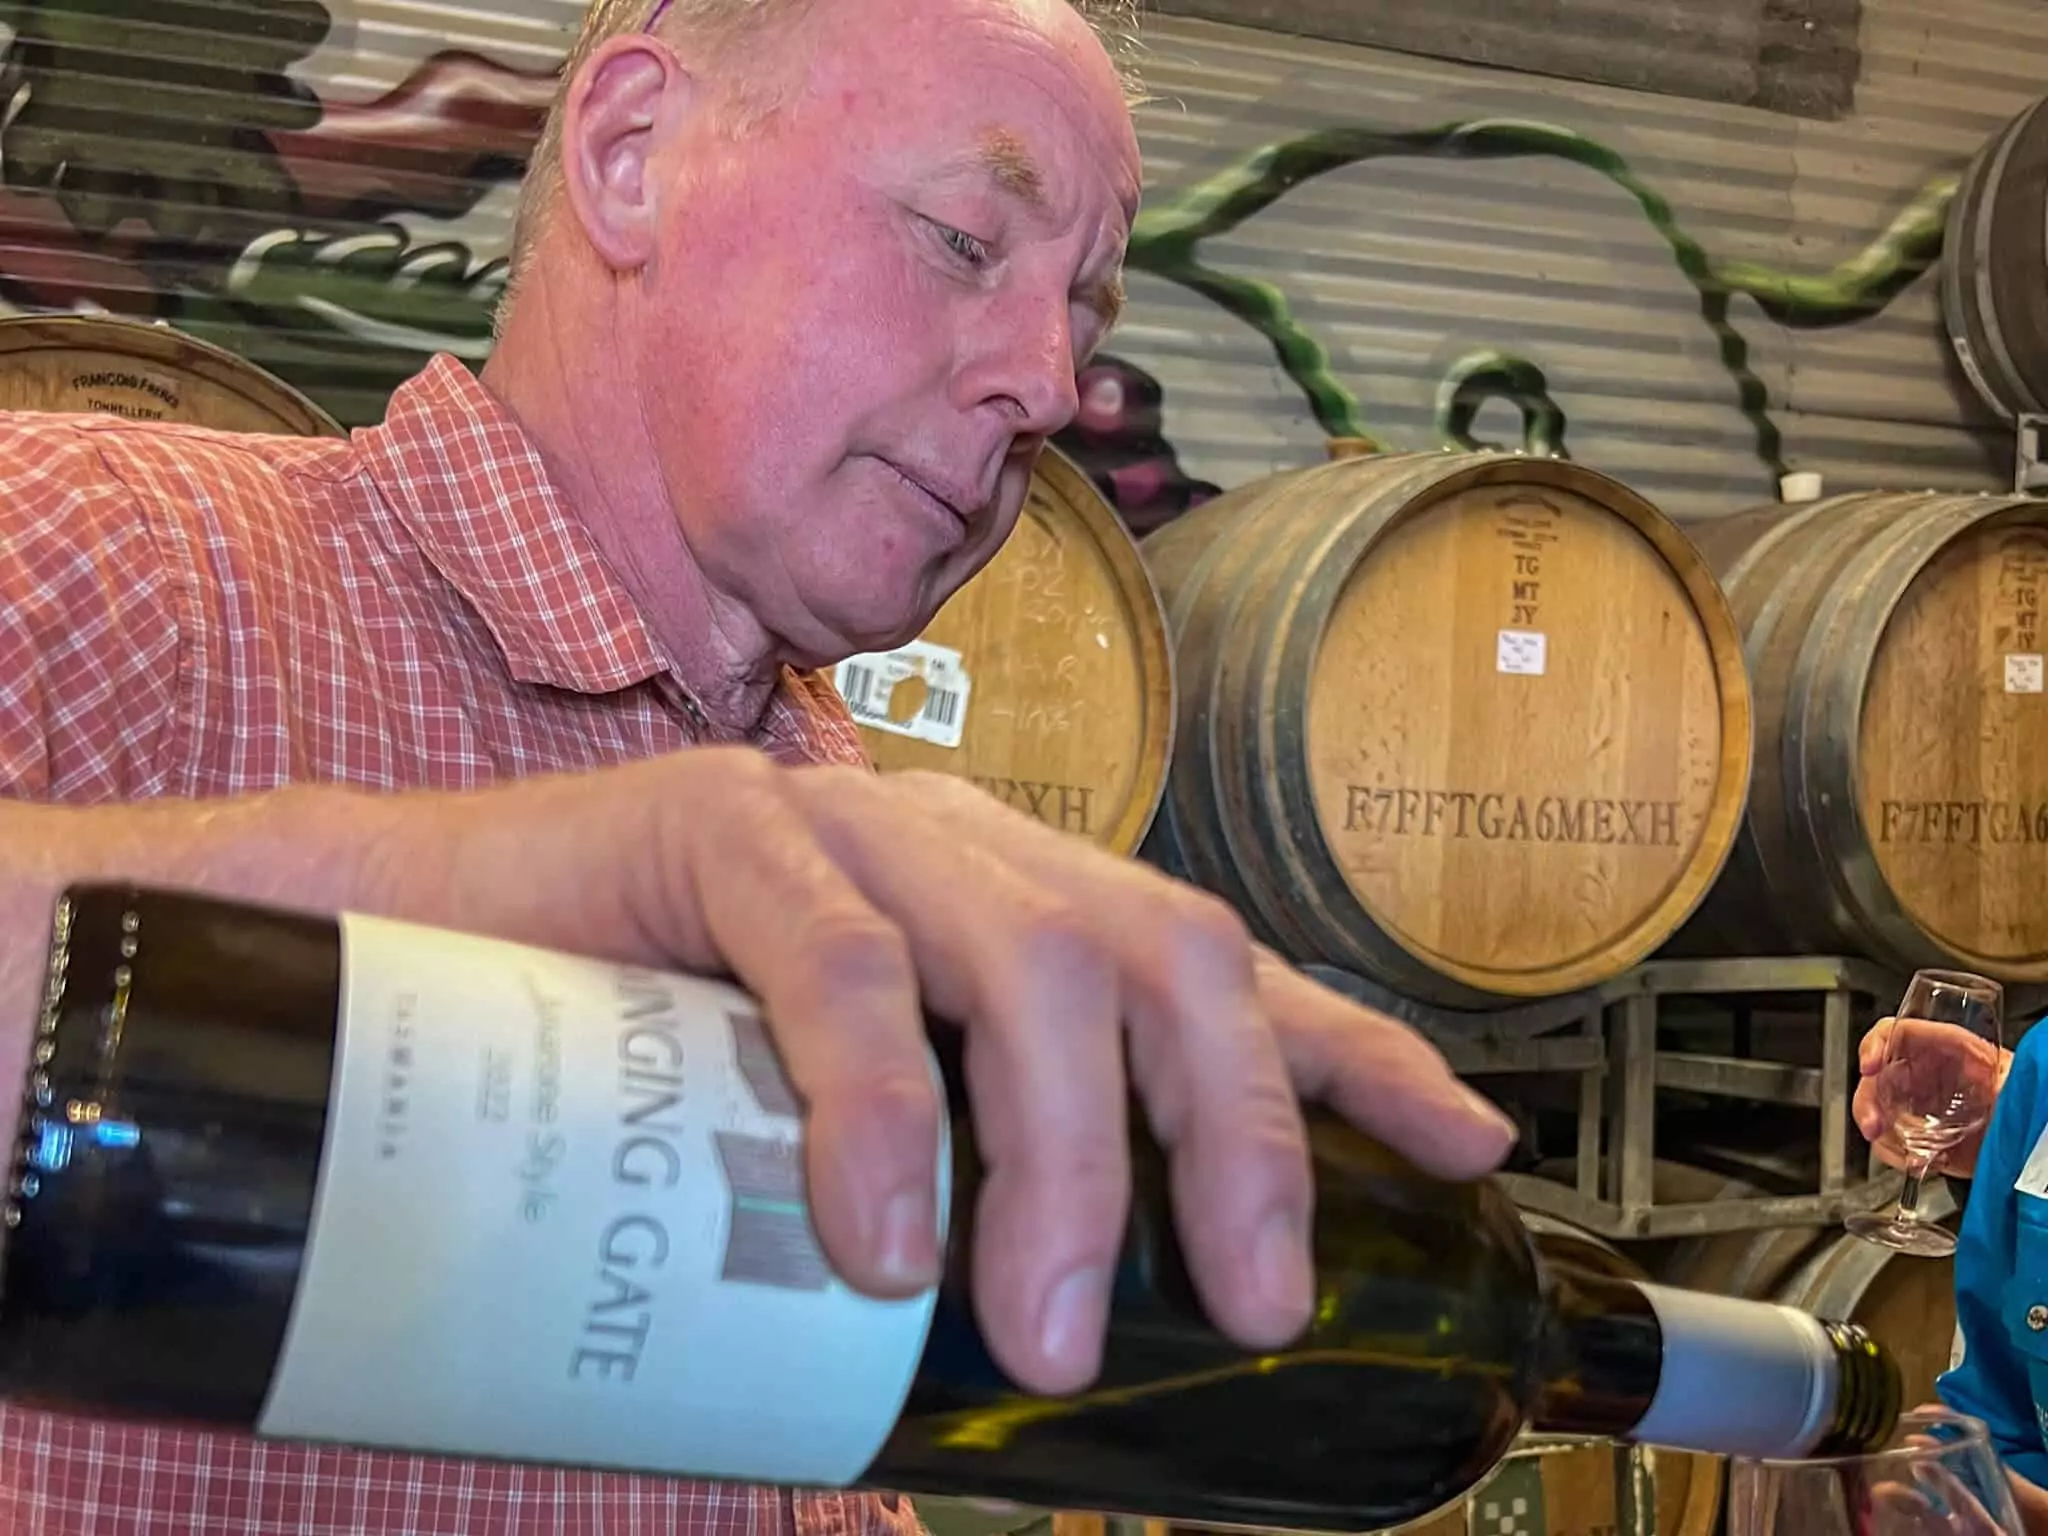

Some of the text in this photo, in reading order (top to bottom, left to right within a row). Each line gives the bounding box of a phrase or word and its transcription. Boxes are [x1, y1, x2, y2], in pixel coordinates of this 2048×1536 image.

[1513, 554, 1541, 575] TG
[972, 775, 1095, 835] EXH
[1343, 784, 1681, 846] F7FFTGA6MEXH
[513, 1129, 567, 1223] Style
[567, 1214, 670, 1382] GATE
